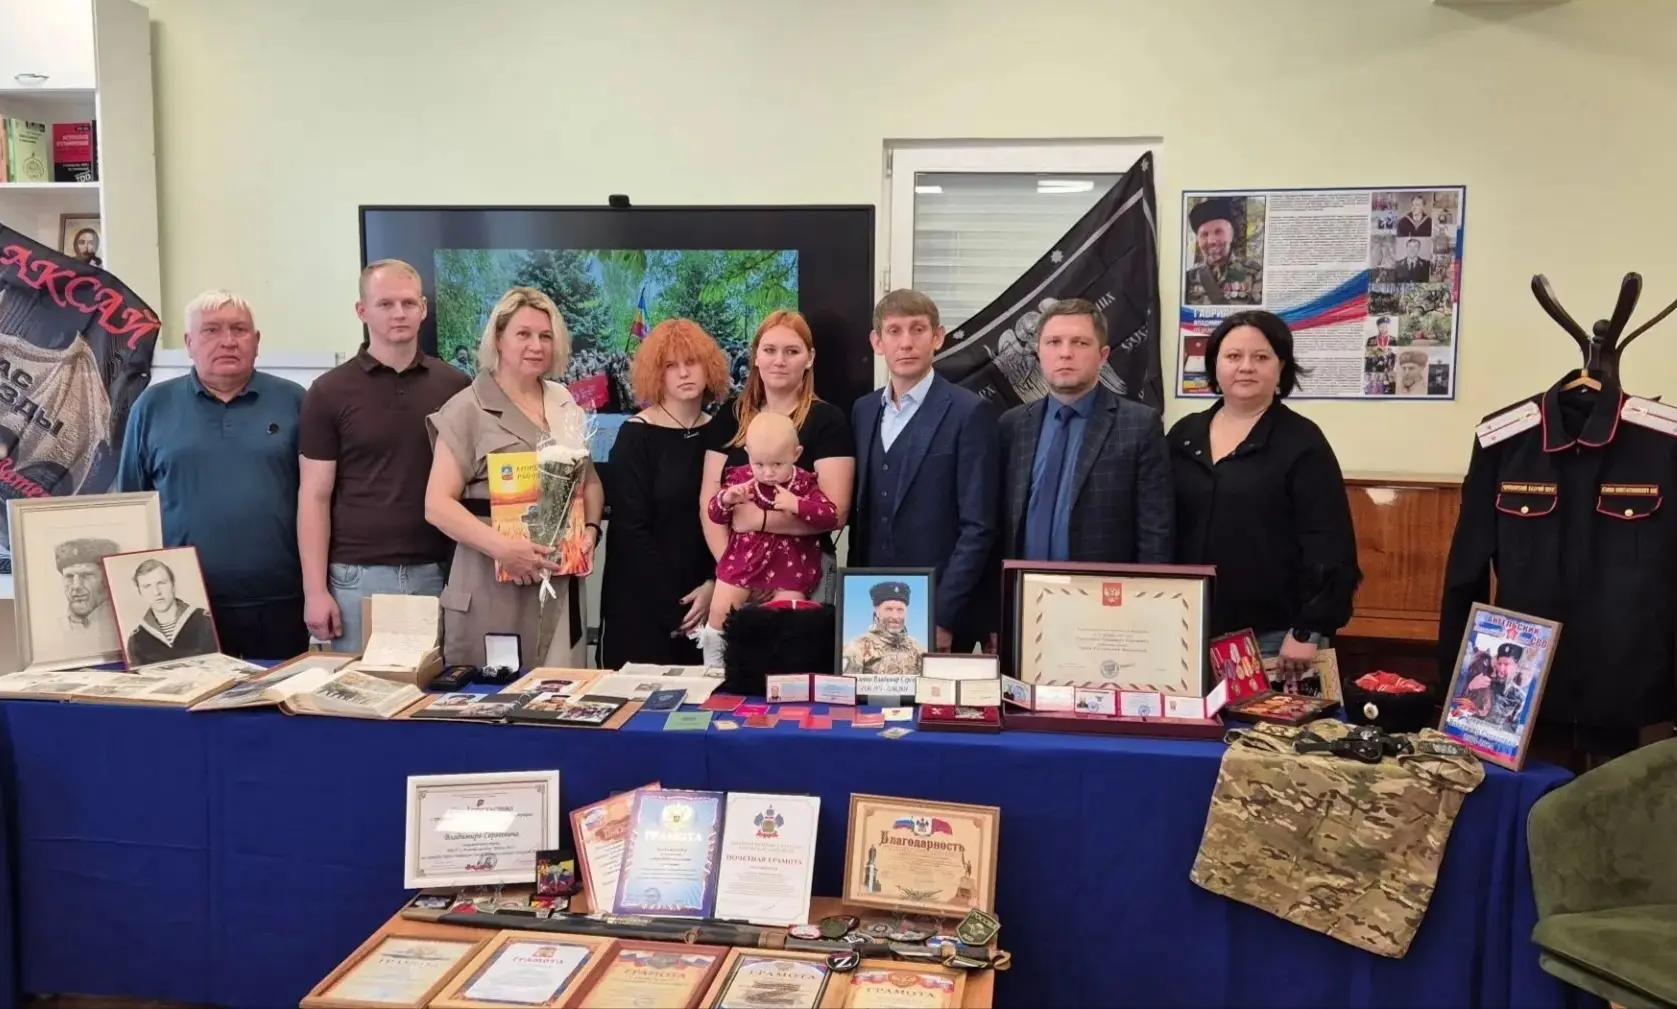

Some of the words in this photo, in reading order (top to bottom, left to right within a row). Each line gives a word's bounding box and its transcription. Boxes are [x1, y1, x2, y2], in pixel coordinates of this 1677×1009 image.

[2, 244, 161, 350] АКСАЙ
[644, 831, 703, 842] ГРАМОТА
[879, 830, 966, 852] Благодарность
[749, 969, 817, 981] ГРАМОТА
[865, 986, 936, 1000] ГРАМОТА
